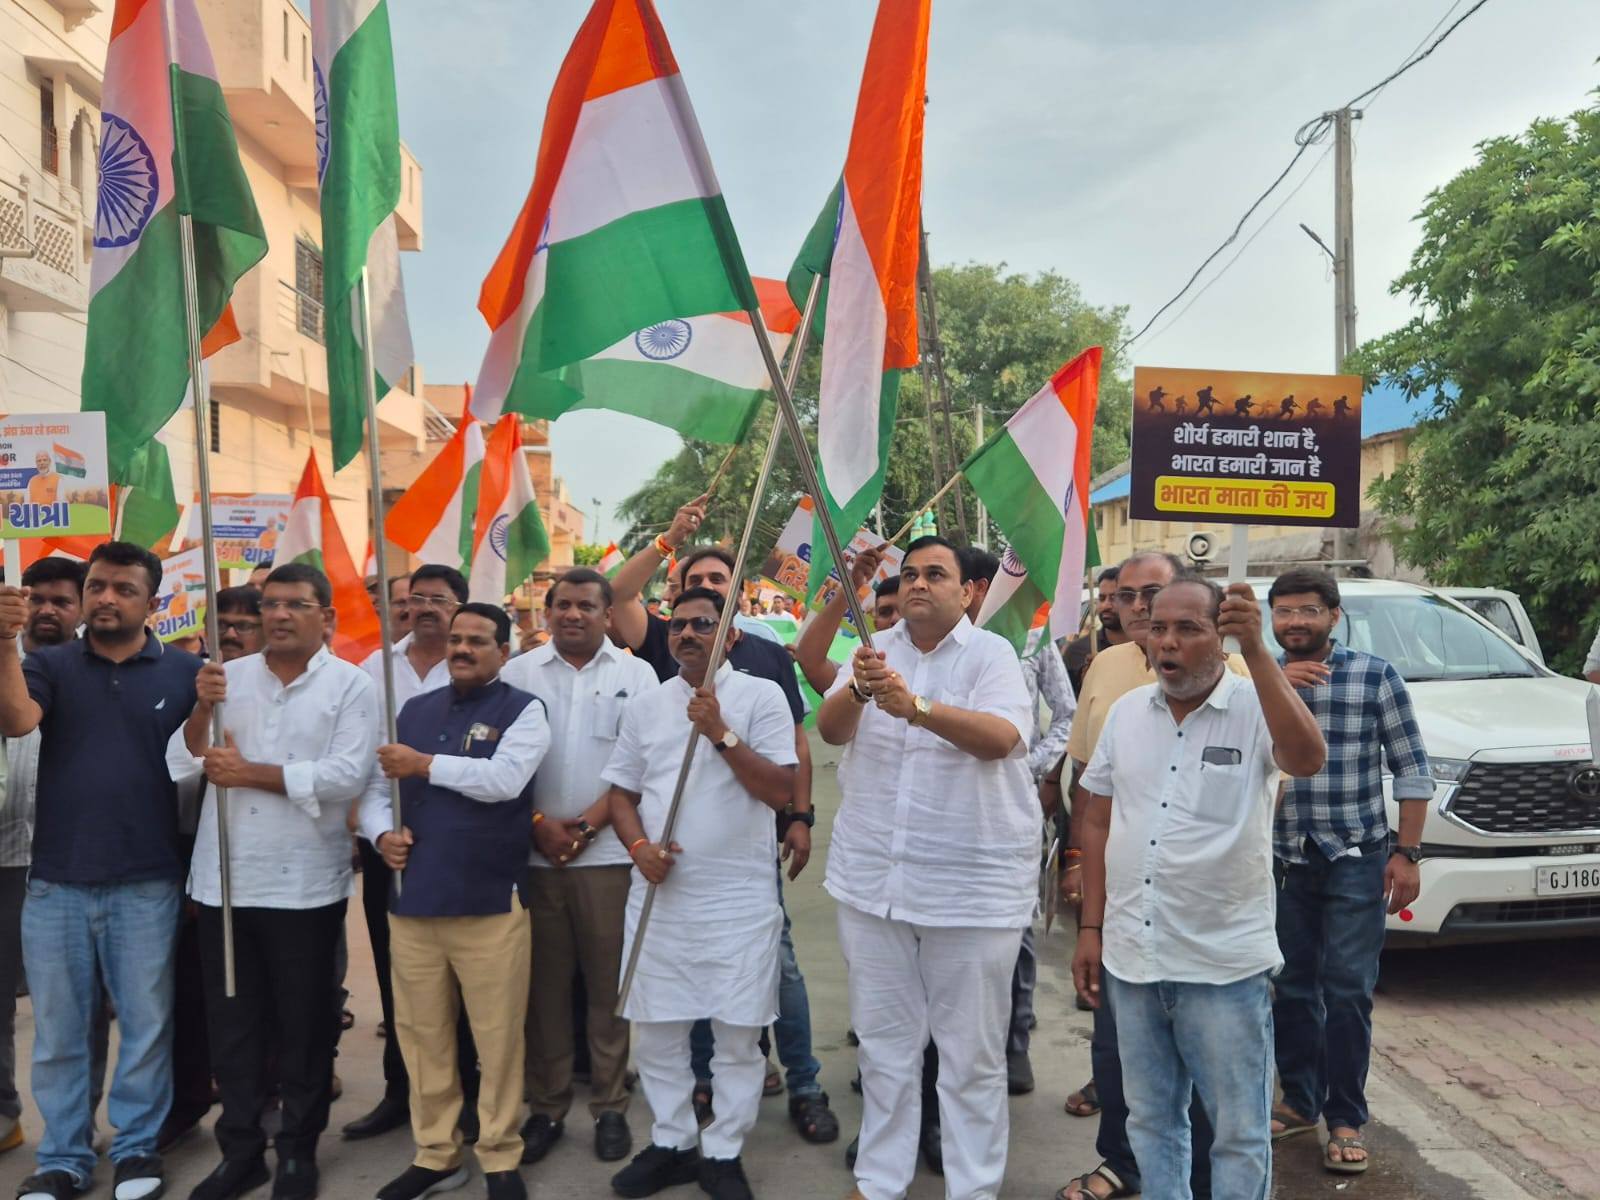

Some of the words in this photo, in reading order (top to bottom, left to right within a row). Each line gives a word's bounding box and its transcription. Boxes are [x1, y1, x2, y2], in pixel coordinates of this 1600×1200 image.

[1173, 422, 1210, 445] शौर्य
[1211, 425, 1261, 447] हमारी
[1263, 429, 1300, 449] शान
[1171, 453, 1214, 473] भारत
[1218, 454, 1267, 475] हमारी
[1269, 458, 1306, 477] जान
[1309, 455, 1322, 477] है
[1160, 483, 1212, 506] भारत
[1215, 485, 1262, 508] माता
[1263, 483, 1291, 509] की
[1293, 489, 1328, 511] जय
[9, 502, 70, 529] યાત્રા
[1550, 869, 1600, 890] GJ18G
